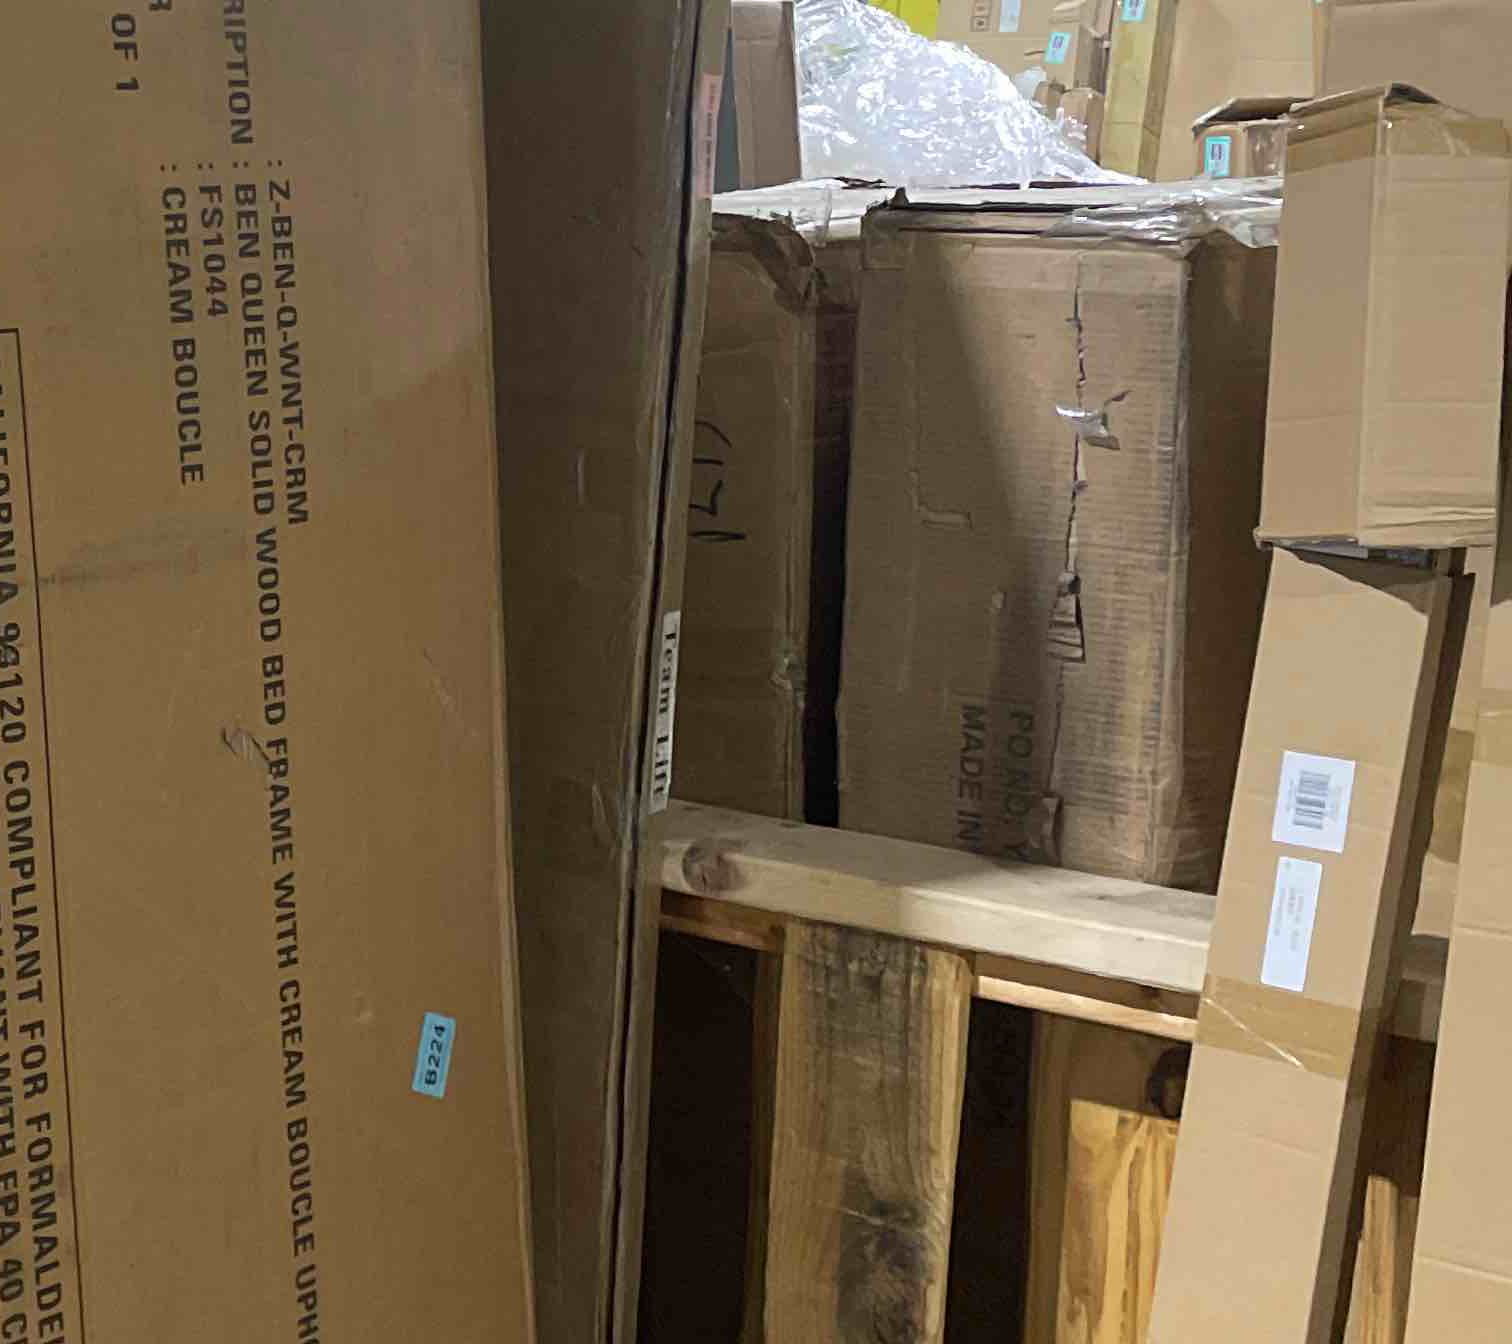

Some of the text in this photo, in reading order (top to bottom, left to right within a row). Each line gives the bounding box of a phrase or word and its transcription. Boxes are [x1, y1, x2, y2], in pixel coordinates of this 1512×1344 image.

[111, 13, 138, 61] OF
[116, 77, 140, 92] 1
[162, 187, 194, 324] CREAM
[197, 184, 229, 317] FS1044
[235, 183, 261, 258] BEN
[239, 273, 268, 396] QUEEN
[268, 179, 309, 524] Z-BEN-Q-WNT-CRM
[172, 338, 205, 486] BOUCLE
[248, 411, 275, 515] SOLID
[255, 527, 282, 642] WOOD
[261, 655, 287, 726] BED
[658, 624, 677, 717] Team
[956, 704, 989, 841] MADE IN
[1007, 709, 1036, 758] PO
[265, 738, 294, 865] FRAME
[2, 760, 44, 1003] COMPLIANT
[273, 872, 299, 969] WITH
[19, 1020, 48, 1100] FOR
[279, 979, 307, 1109] CREAM
[422, 1024, 445, 1087] B224
[287, 1118, 316, 1257] BOUCLE
